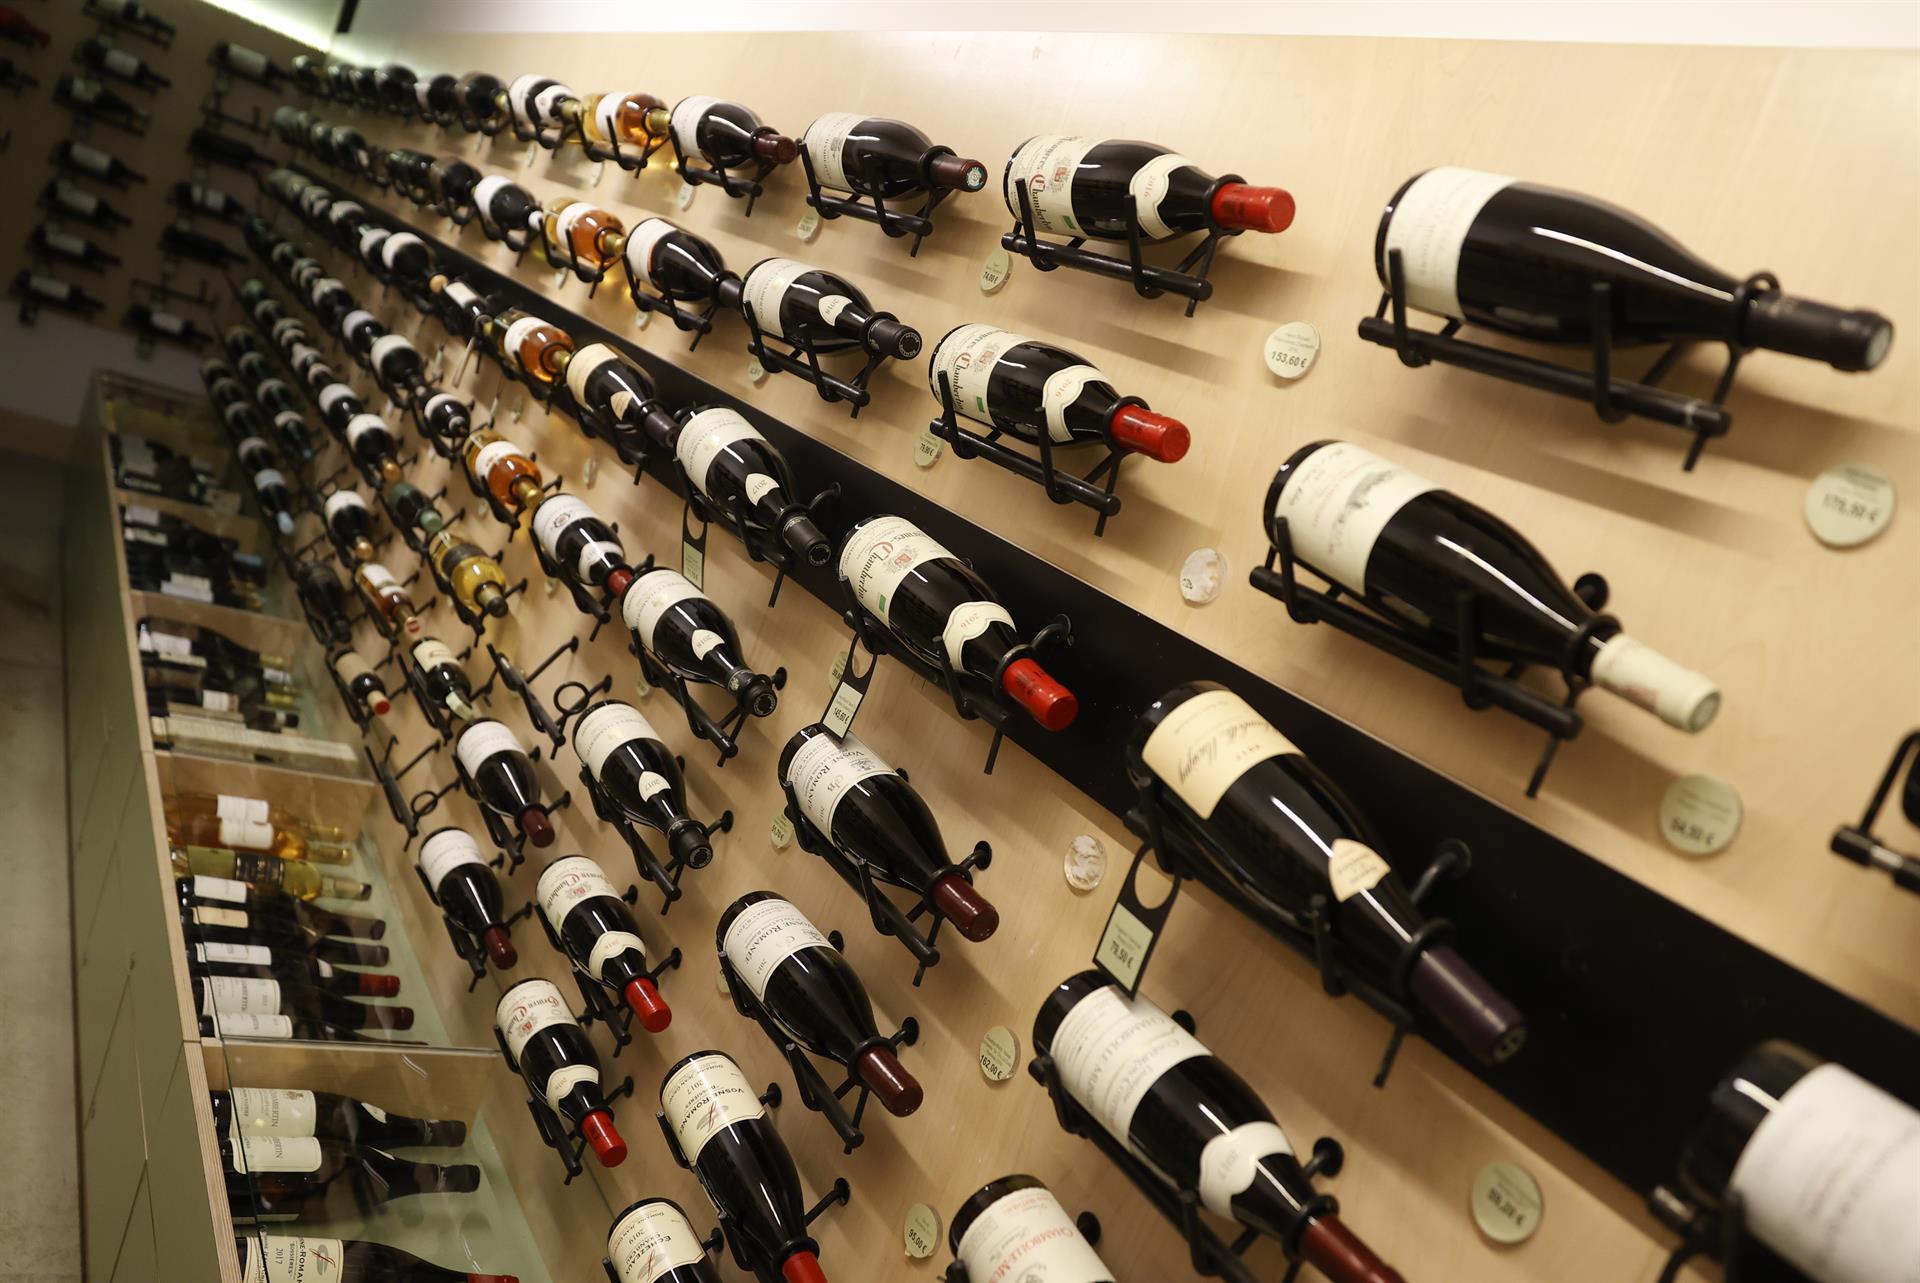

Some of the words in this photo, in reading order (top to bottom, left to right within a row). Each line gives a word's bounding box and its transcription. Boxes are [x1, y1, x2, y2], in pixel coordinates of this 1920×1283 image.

[1271, 351, 1300, 367] 153,60
[1300, 359, 1308, 369] €
[959, 612, 978, 629] 2016
[980, 1054, 998, 1075] 162,00
[686, 1079, 704, 1095] 2017
[628, 1228, 646, 1244] 2019
[908, 1228, 923, 1249] 95,00
[275, 1247, 284, 1265] 2017
